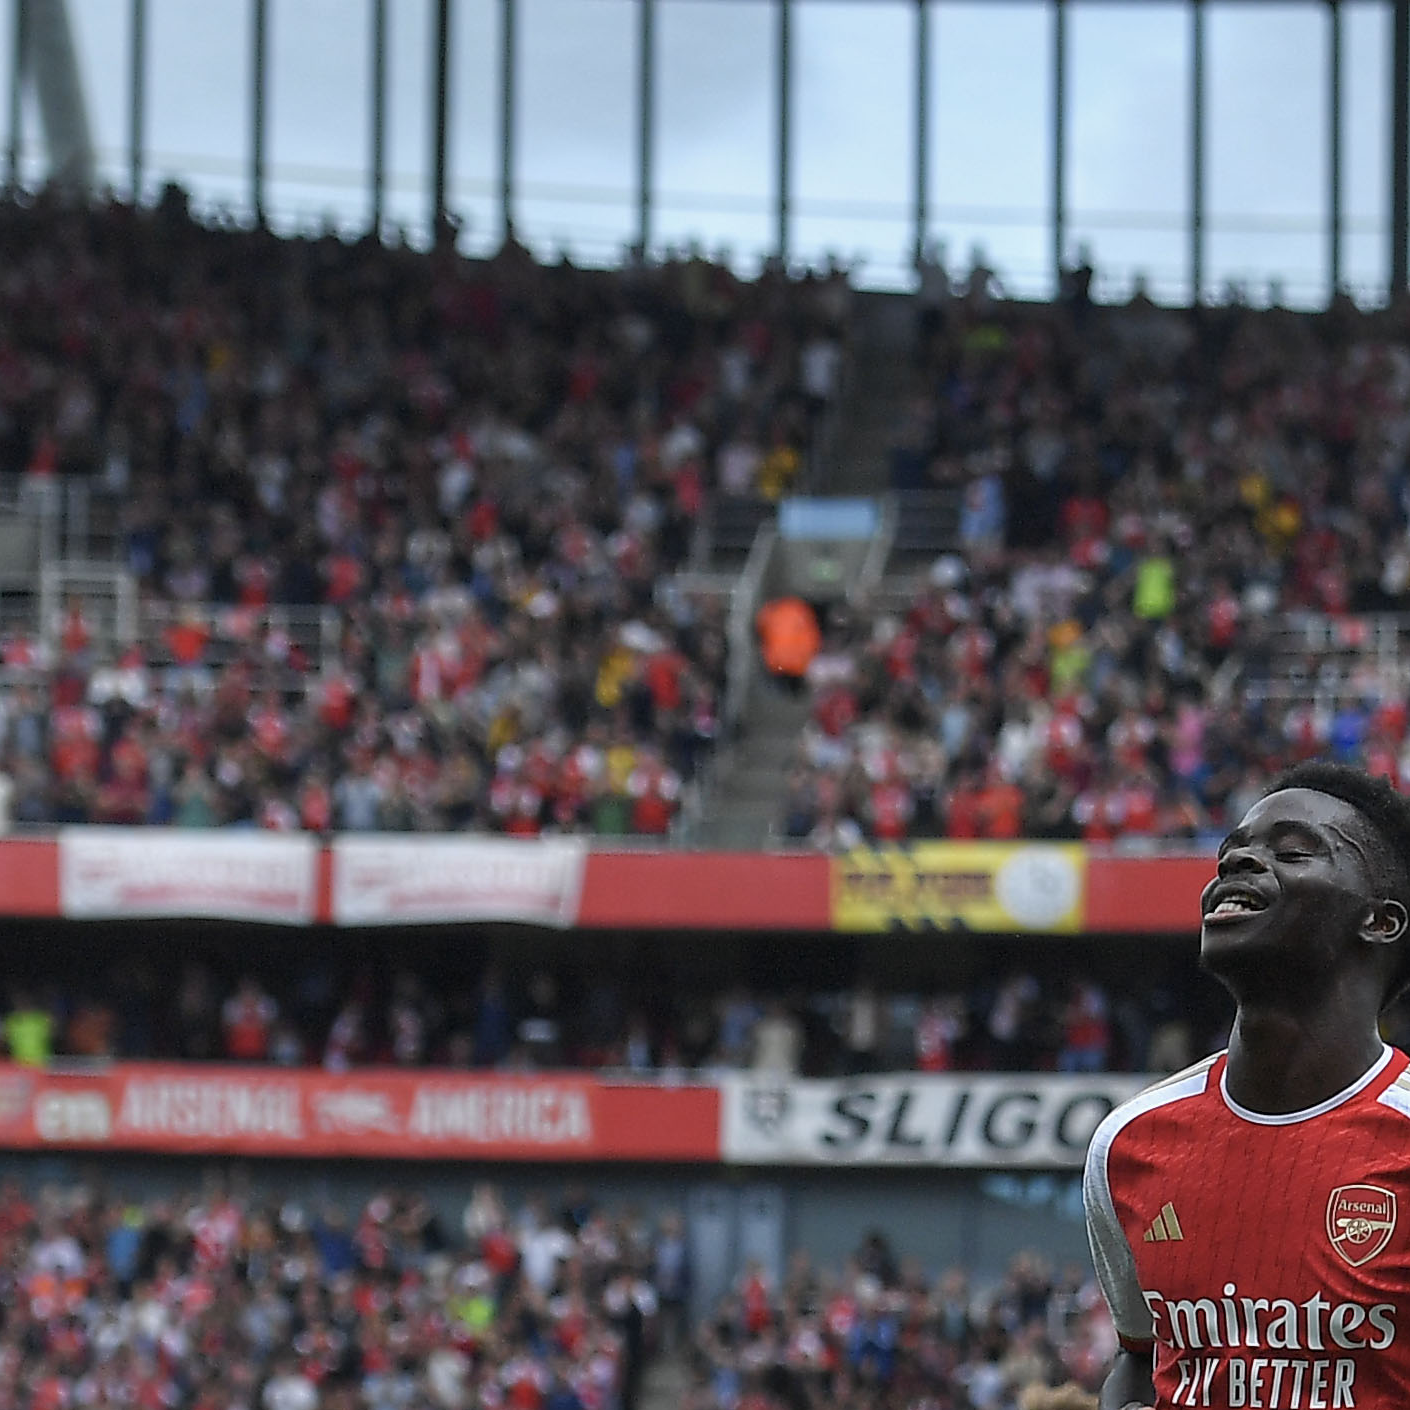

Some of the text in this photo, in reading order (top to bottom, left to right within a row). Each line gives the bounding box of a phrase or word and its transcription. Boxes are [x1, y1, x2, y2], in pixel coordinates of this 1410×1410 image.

[121, 1079, 304, 1140] ARSENAL
[405, 1084, 588, 1143] AMERICA
[822, 1089, 1114, 1151] SLIGO
[1337, 1199, 1386, 1215] Arsenal
[1142, 1282, 1397, 1351] Emirates
[1171, 1357, 1357, 1410] FLY BETTER
